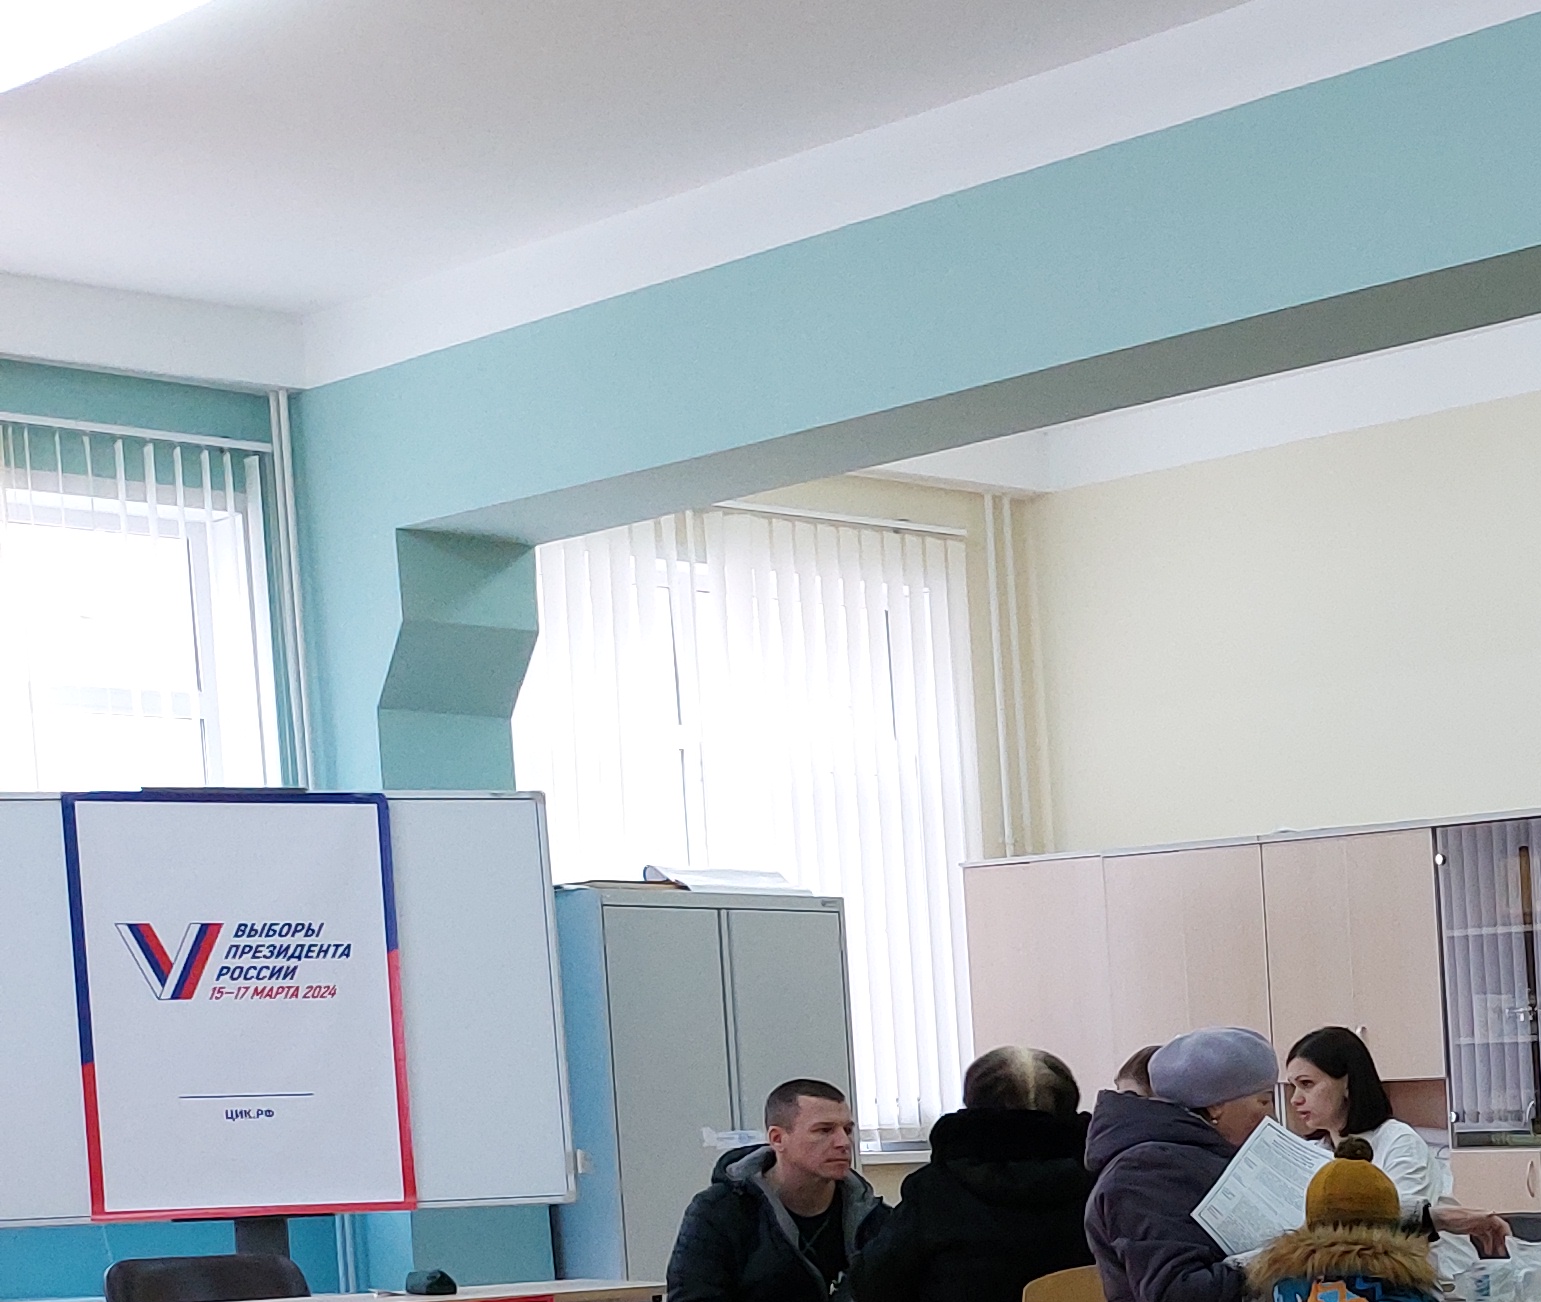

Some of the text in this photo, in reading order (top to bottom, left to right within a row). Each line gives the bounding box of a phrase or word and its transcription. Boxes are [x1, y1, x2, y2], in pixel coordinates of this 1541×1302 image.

[233, 922, 324, 938] ВЫБОРЫ
[224, 943, 352, 961] ПРЕЗИДЕНТА
[215, 965, 299, 981] РОССИИ
[251, 985, 300, 1000] МАРТА
[302, 985, 338, 999] 2024
[225, 1109, 275, 1121] ЦИК.РФ
